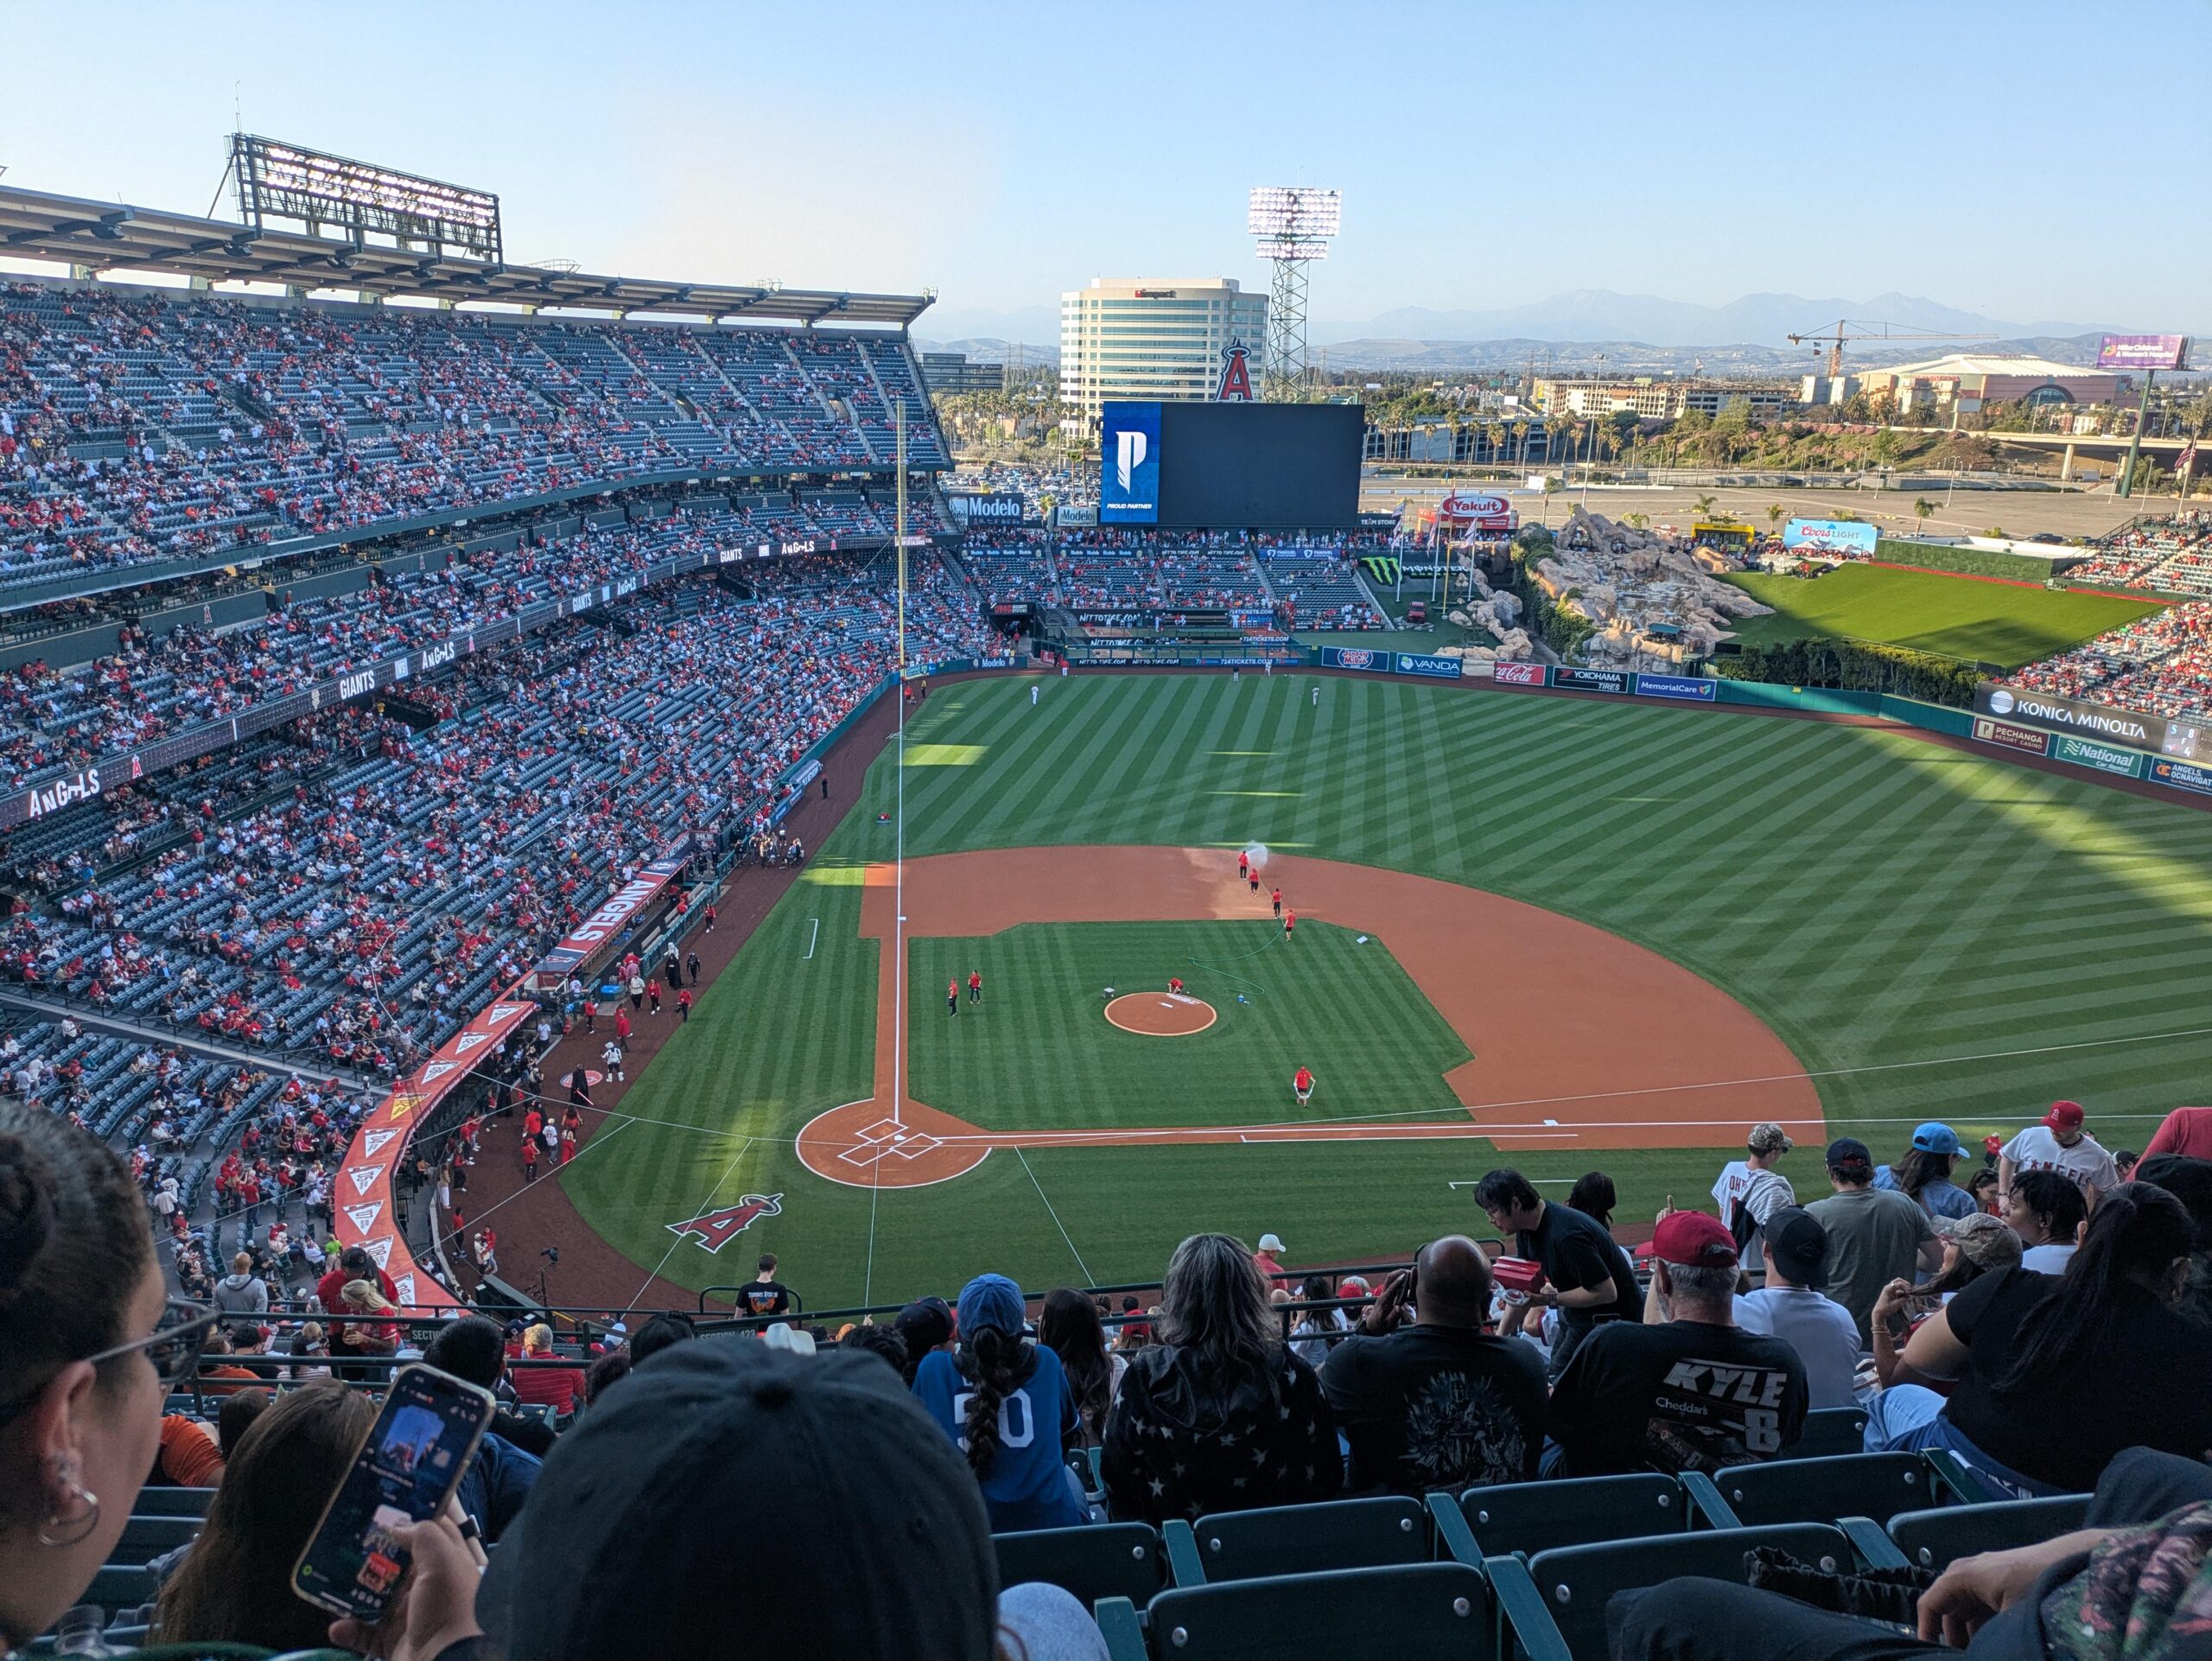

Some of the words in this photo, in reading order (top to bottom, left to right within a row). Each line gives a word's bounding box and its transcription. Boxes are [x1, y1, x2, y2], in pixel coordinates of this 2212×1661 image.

[969, 497, 1020, 516] Modelo
[1453, 501, 1498, 512] Yakult
[1062, 509, 1093, 521] Modelo
[1801, 525, 1831, 538] Coors
[1831, 530, 1860, 539] LIGHT
[720, 548, 743, 563] GIANTS
[572, 592, 592, 613] GIANTS
[982, 658, 1006, 668] Modelo
[1414, 659, 1460, 671] VANDA
[1573, 671, 1621, 682] YOKOHAMA
[340, 669, 376, 700] GIANTS
[1599, 683, 1620, 691] TIRES
[1641, 681, 1697, 693] MemorialCare
[2017, 700, 2075, 724] KONICA
[2076, 713, 2145, 740] MINOLTA
[1995, 727, 2043, 745] PECHANGA
[2188, 729, 2195, 739] 8
[1994, 735, 2018, 743] RESORT
[2019, 740, 2043, 750] CASINO
[2079, 744, 2134, 767] National
[2183, 747, 2191, 757] 4
[2107, 762, 2129, 773] Rental
[570, 879, 658, 941] ANGELS
[1729, 1175, 1748, 1193] OHT
[412, 1330, 442, 1341] SECTI
[1663, 1362, 1788, 1408] KYLE
[1656, 1397, 1708, 1416] Cheddar's
[1744, 1409, 1781, 1453] 8
